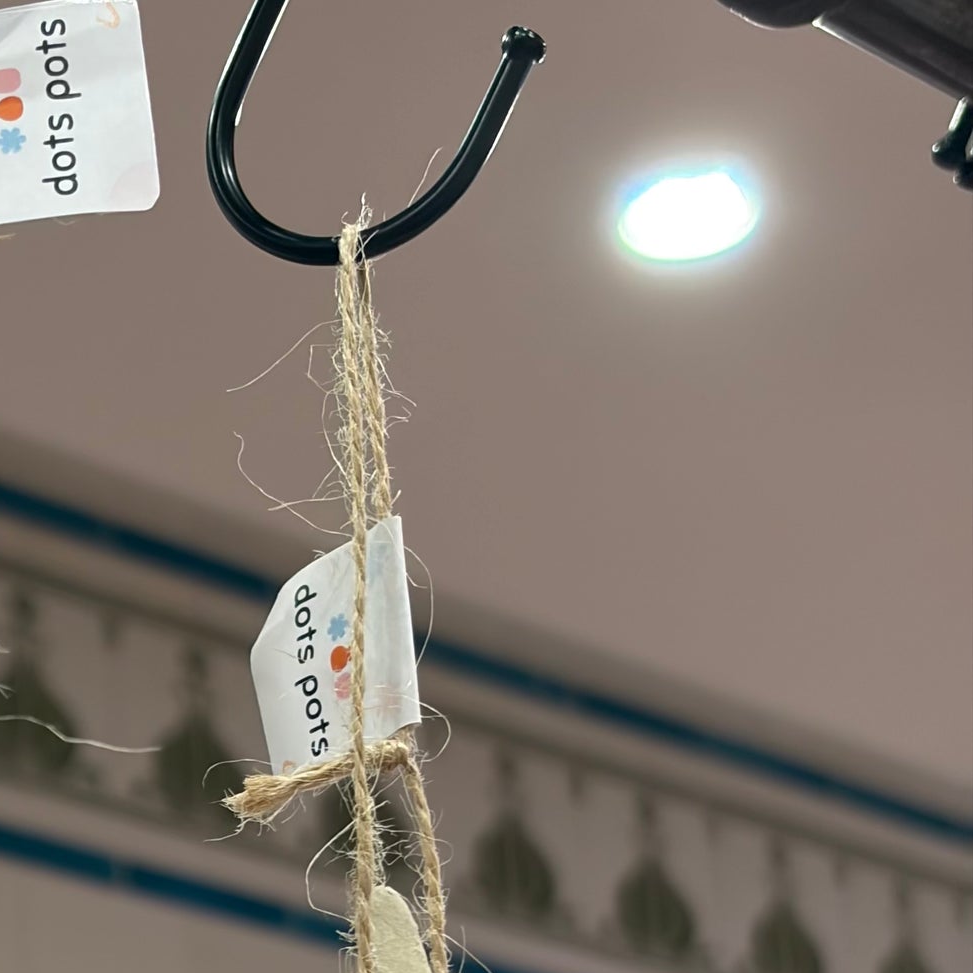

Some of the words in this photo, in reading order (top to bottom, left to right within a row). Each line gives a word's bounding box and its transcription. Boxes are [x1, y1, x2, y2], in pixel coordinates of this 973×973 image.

[35, 18, 82, 100] pots
[42, 113, 78, 195] dots
[294, 584, 317, 664] dots
[294, 674, 330, 757] pots
